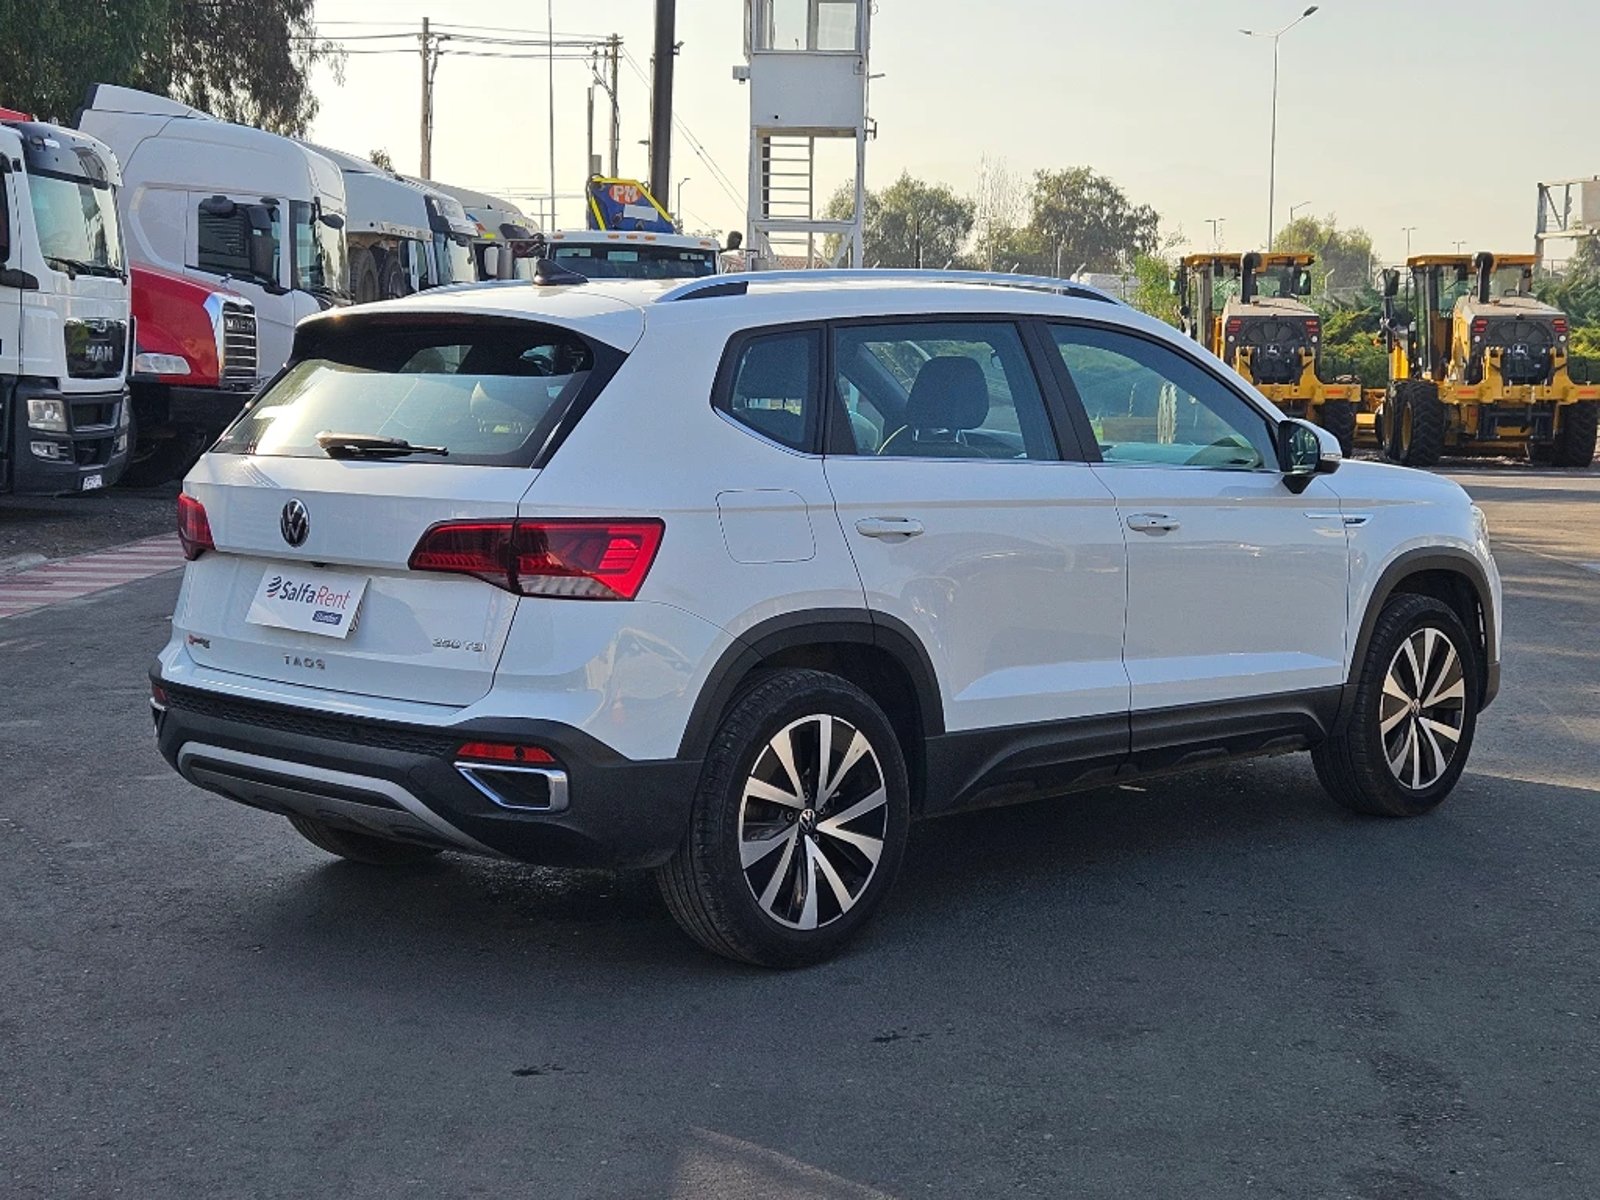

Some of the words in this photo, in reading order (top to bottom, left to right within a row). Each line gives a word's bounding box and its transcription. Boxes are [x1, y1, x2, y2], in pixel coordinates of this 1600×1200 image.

[613, 185, 639, 202] PM
[86, 345, 113, 361] MAN
[280, 581, 351, 609] SalfaRent
[284, 655, 326, 670] TAOS
